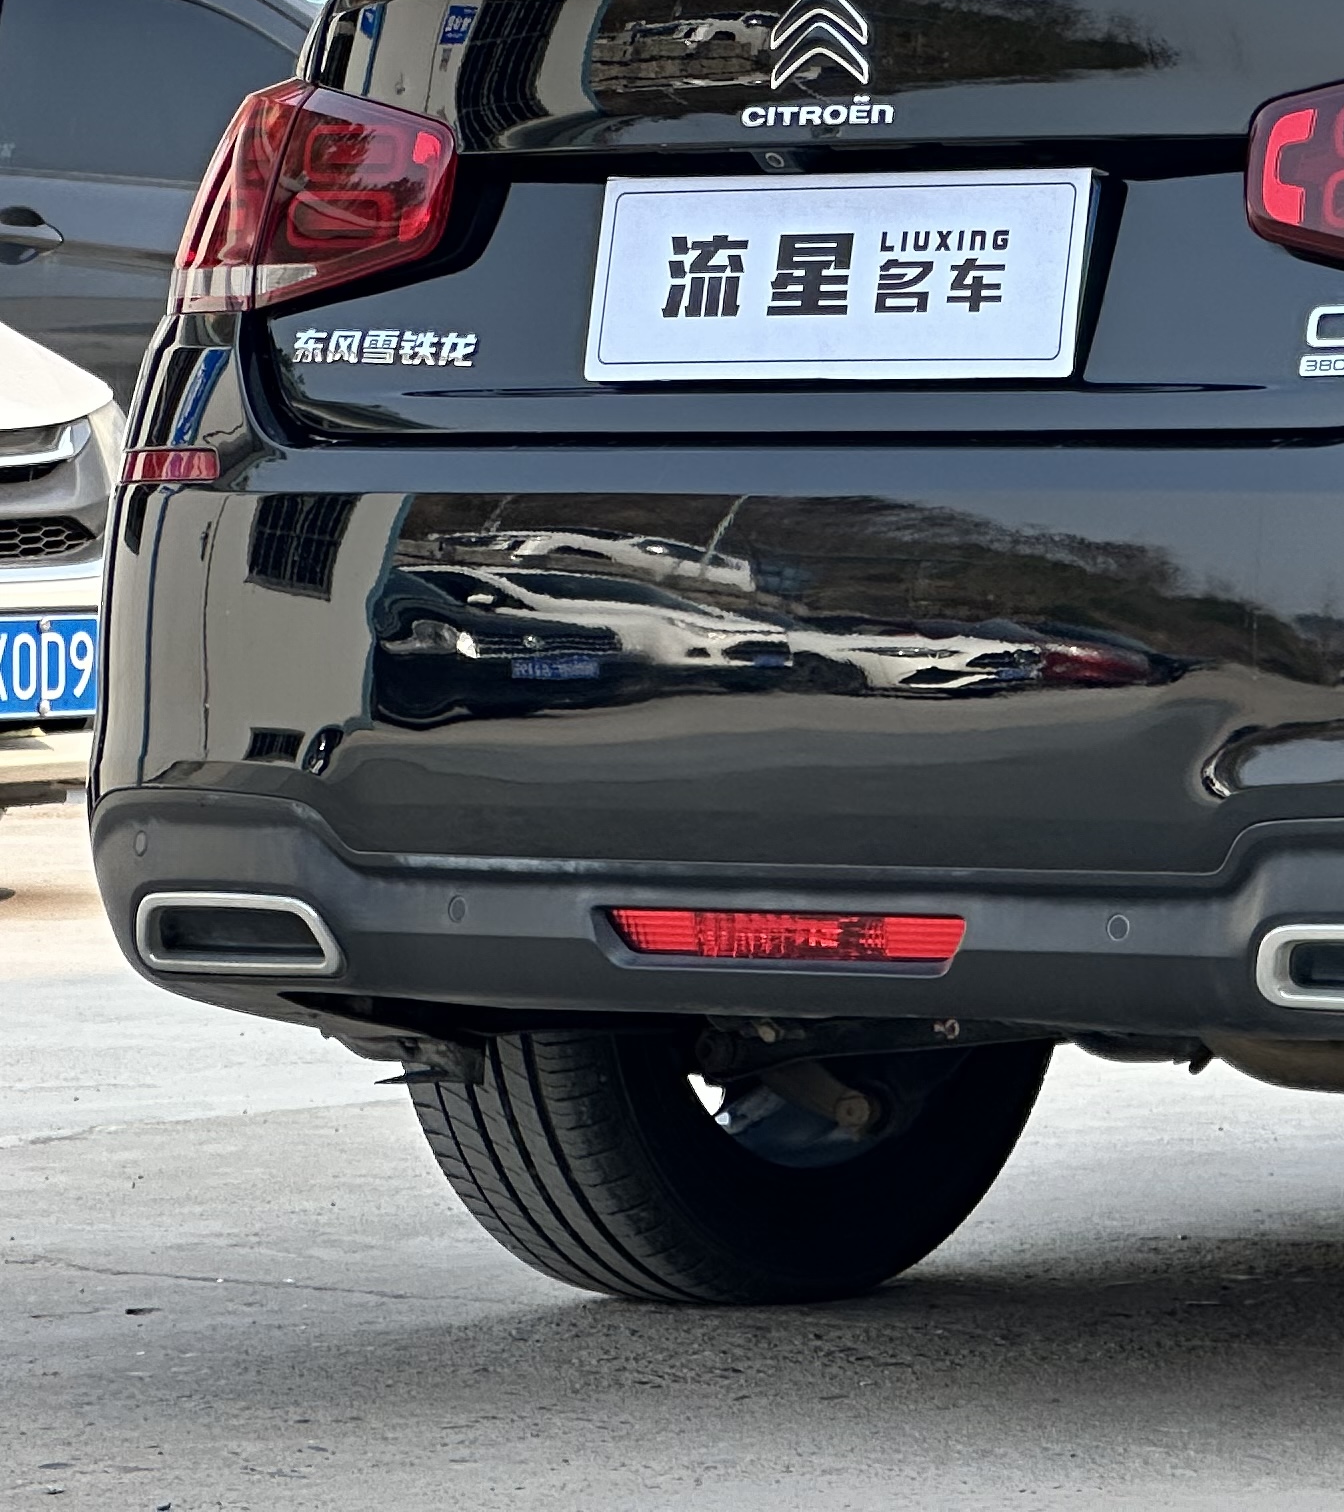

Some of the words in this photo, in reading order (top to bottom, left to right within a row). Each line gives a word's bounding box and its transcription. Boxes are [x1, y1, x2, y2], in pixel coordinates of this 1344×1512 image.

[880, 229, 1010, 253] LIUXING
[293, 327, 478, 367] 东风雪铁龙
